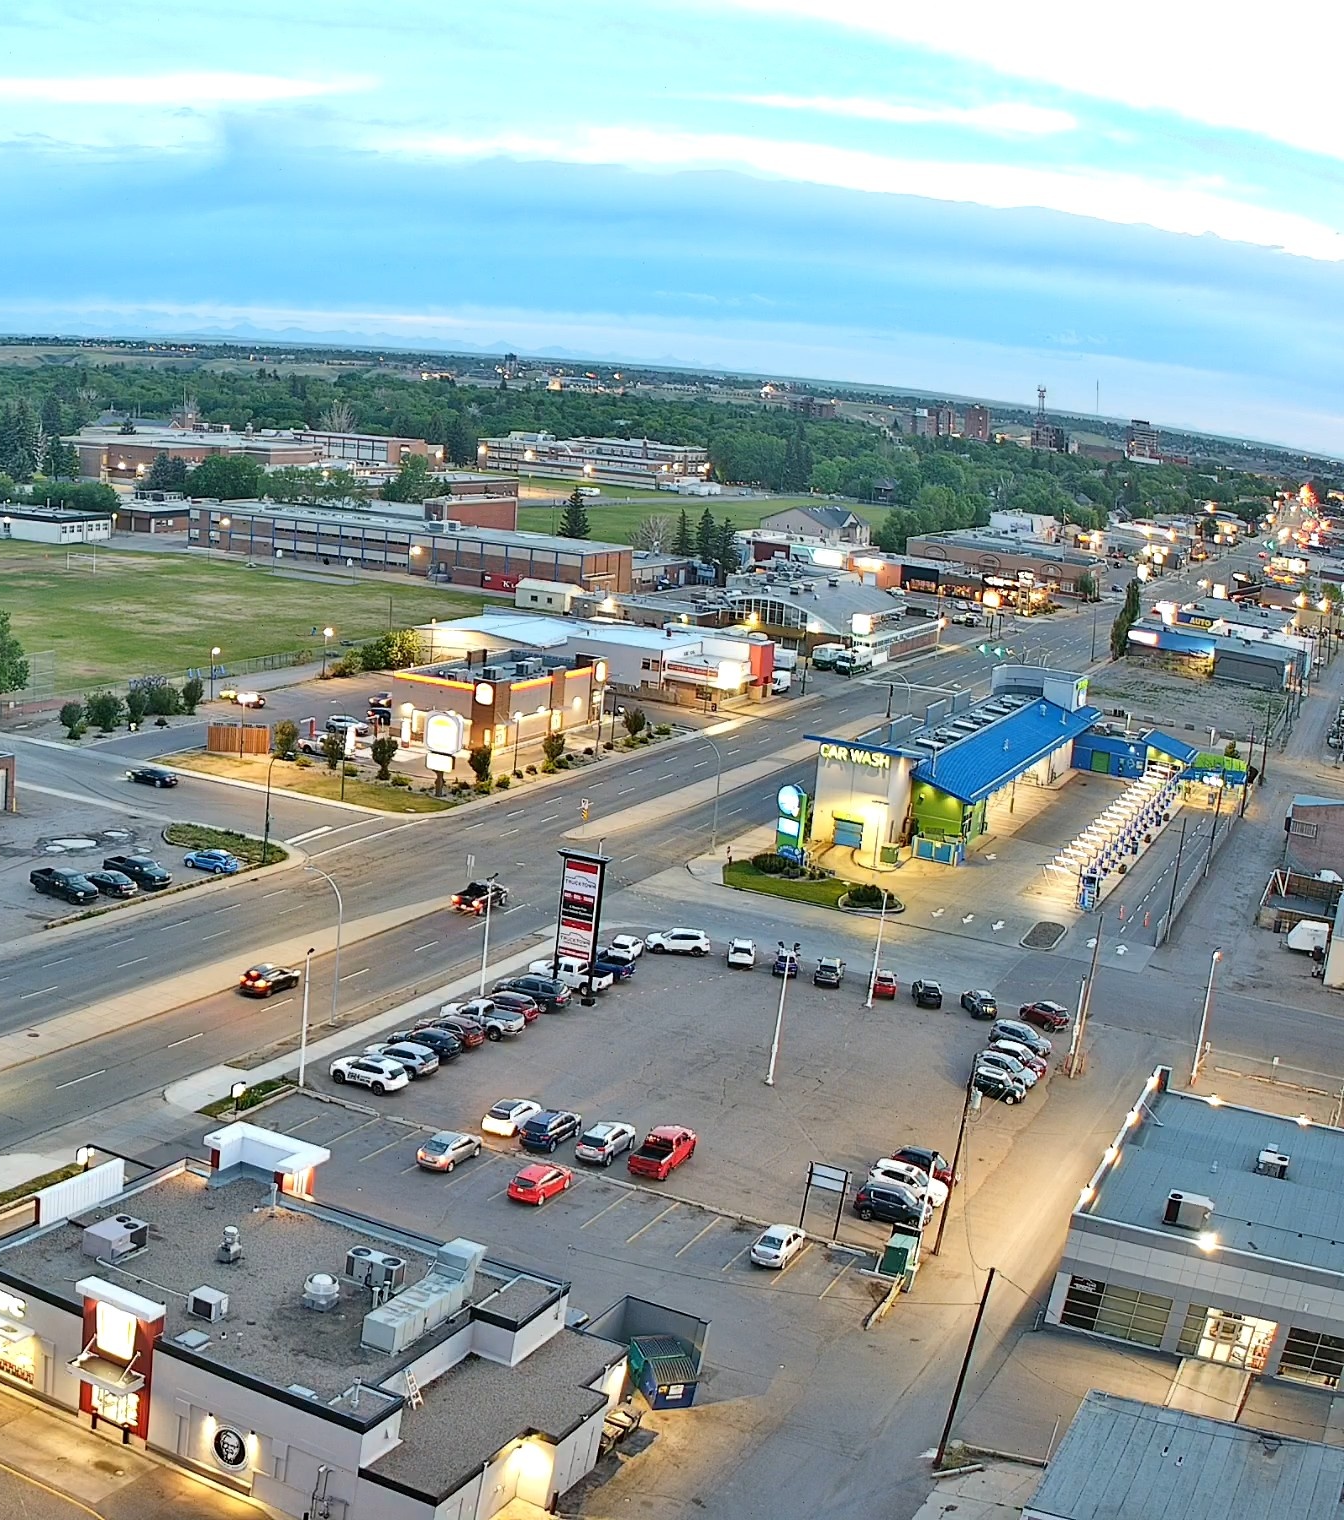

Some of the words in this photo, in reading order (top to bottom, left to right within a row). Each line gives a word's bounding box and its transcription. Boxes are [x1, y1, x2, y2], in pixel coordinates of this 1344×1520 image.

[1189, 616, 1212, 628] AUTO
[820, 743, 849, 762] CAR
[849, 748, 892, 770] WASH
